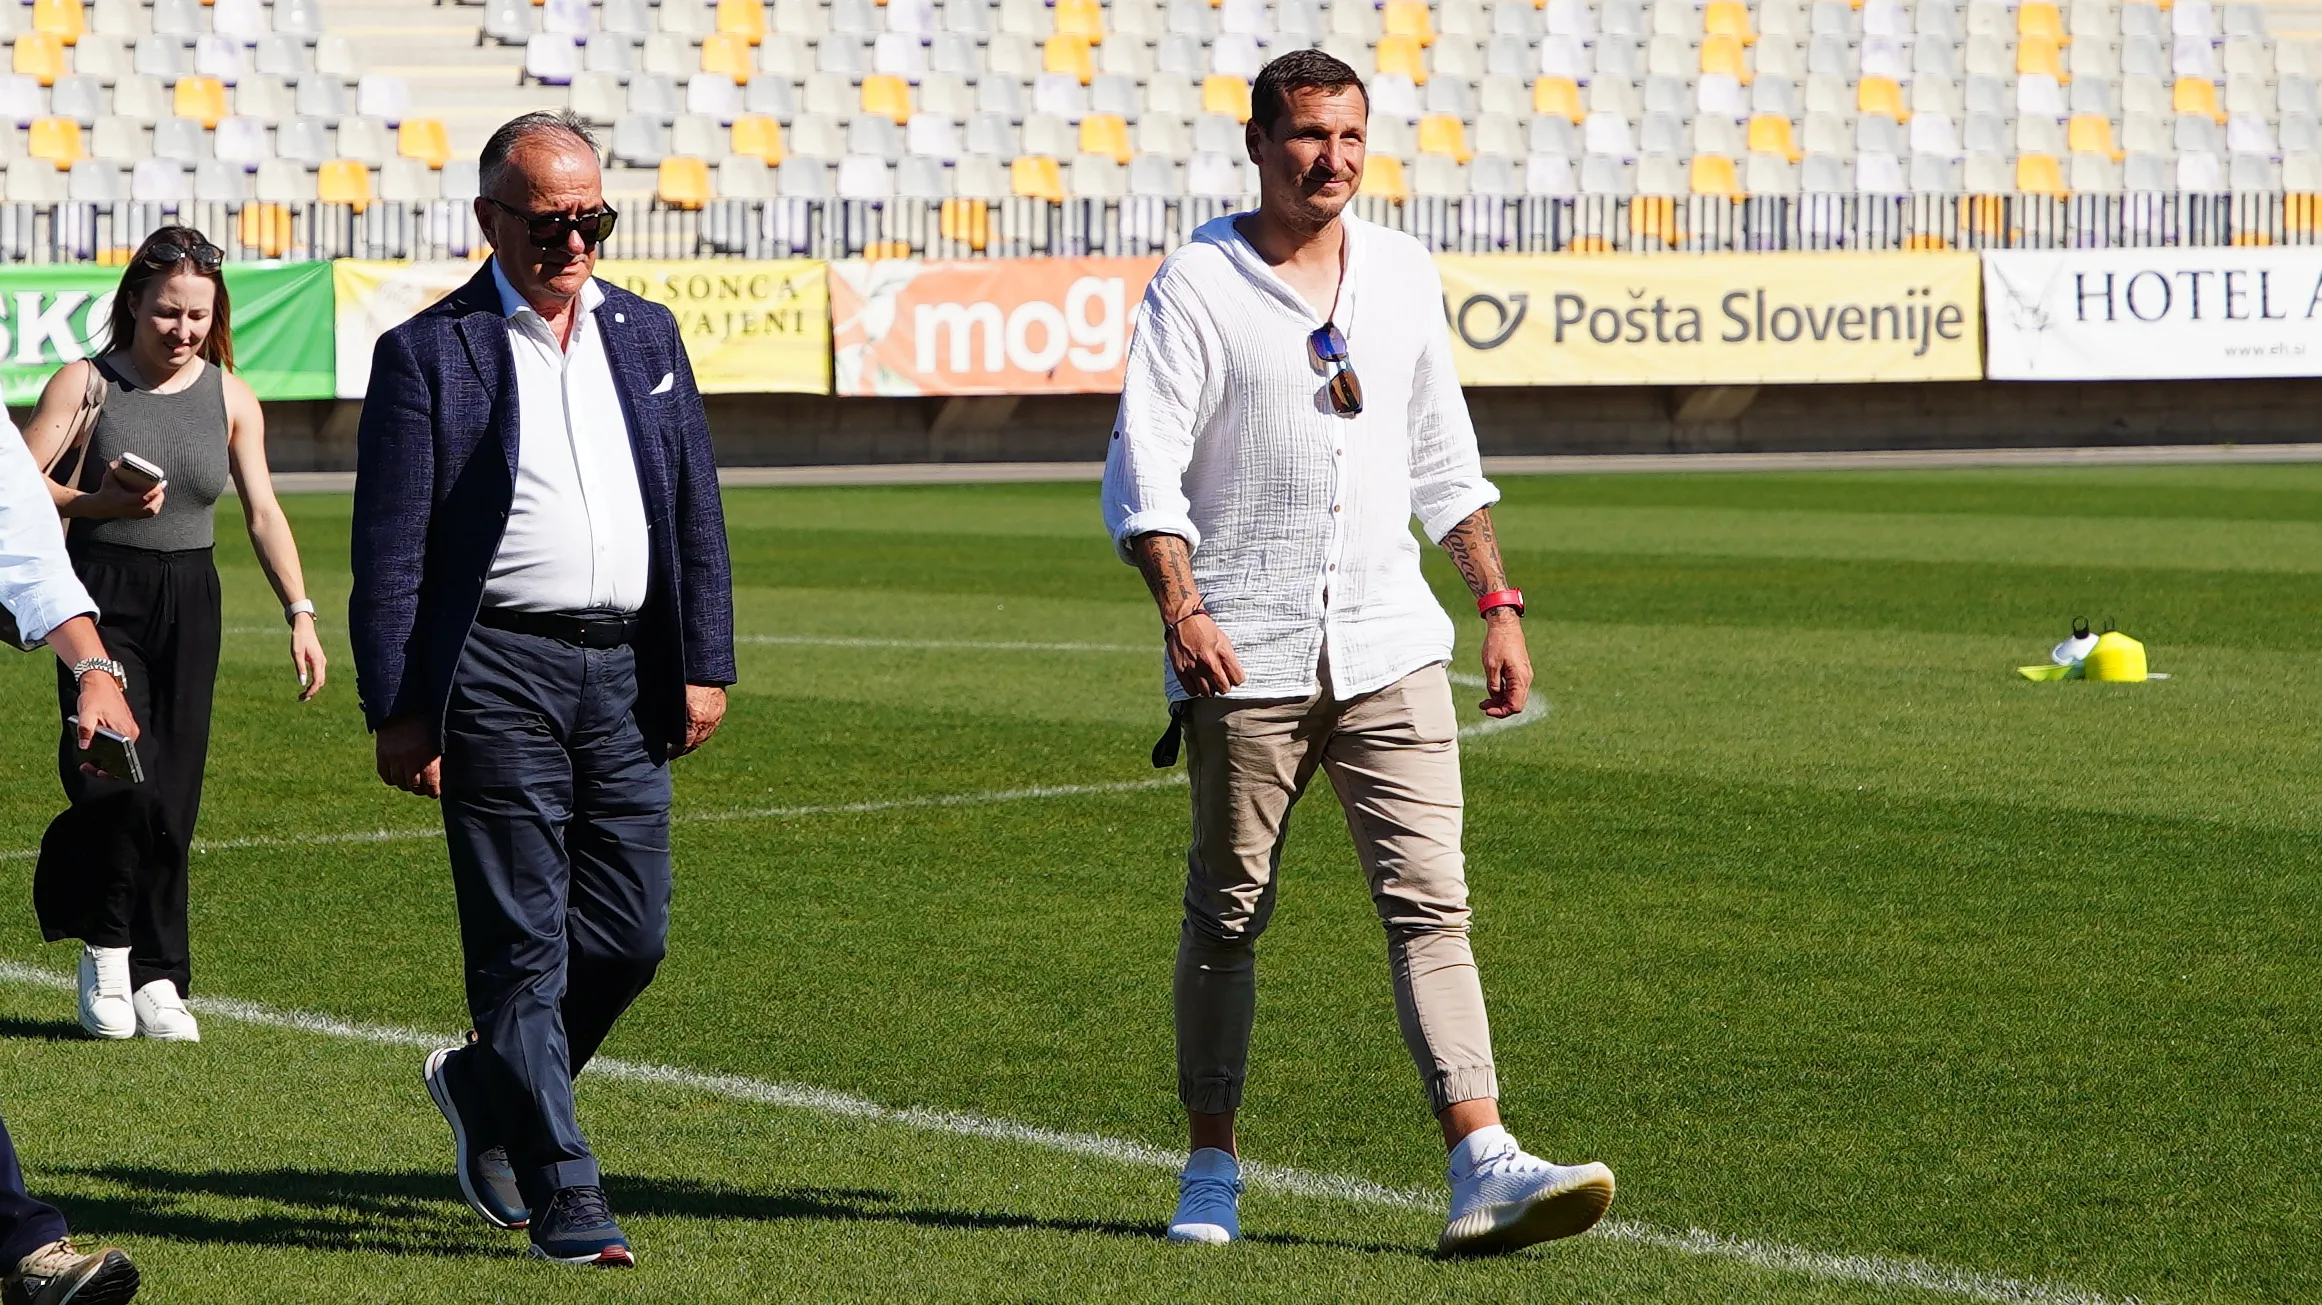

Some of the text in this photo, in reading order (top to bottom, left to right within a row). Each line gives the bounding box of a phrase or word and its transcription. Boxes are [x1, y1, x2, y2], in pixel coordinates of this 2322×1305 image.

[664, 274, 801, 300] SONCA
[2075, 269, 2287, 322] HOTEL
[914, 276, 1142, 373] mog
[1555, 286, 1964, 357] Pošta Slovenije
